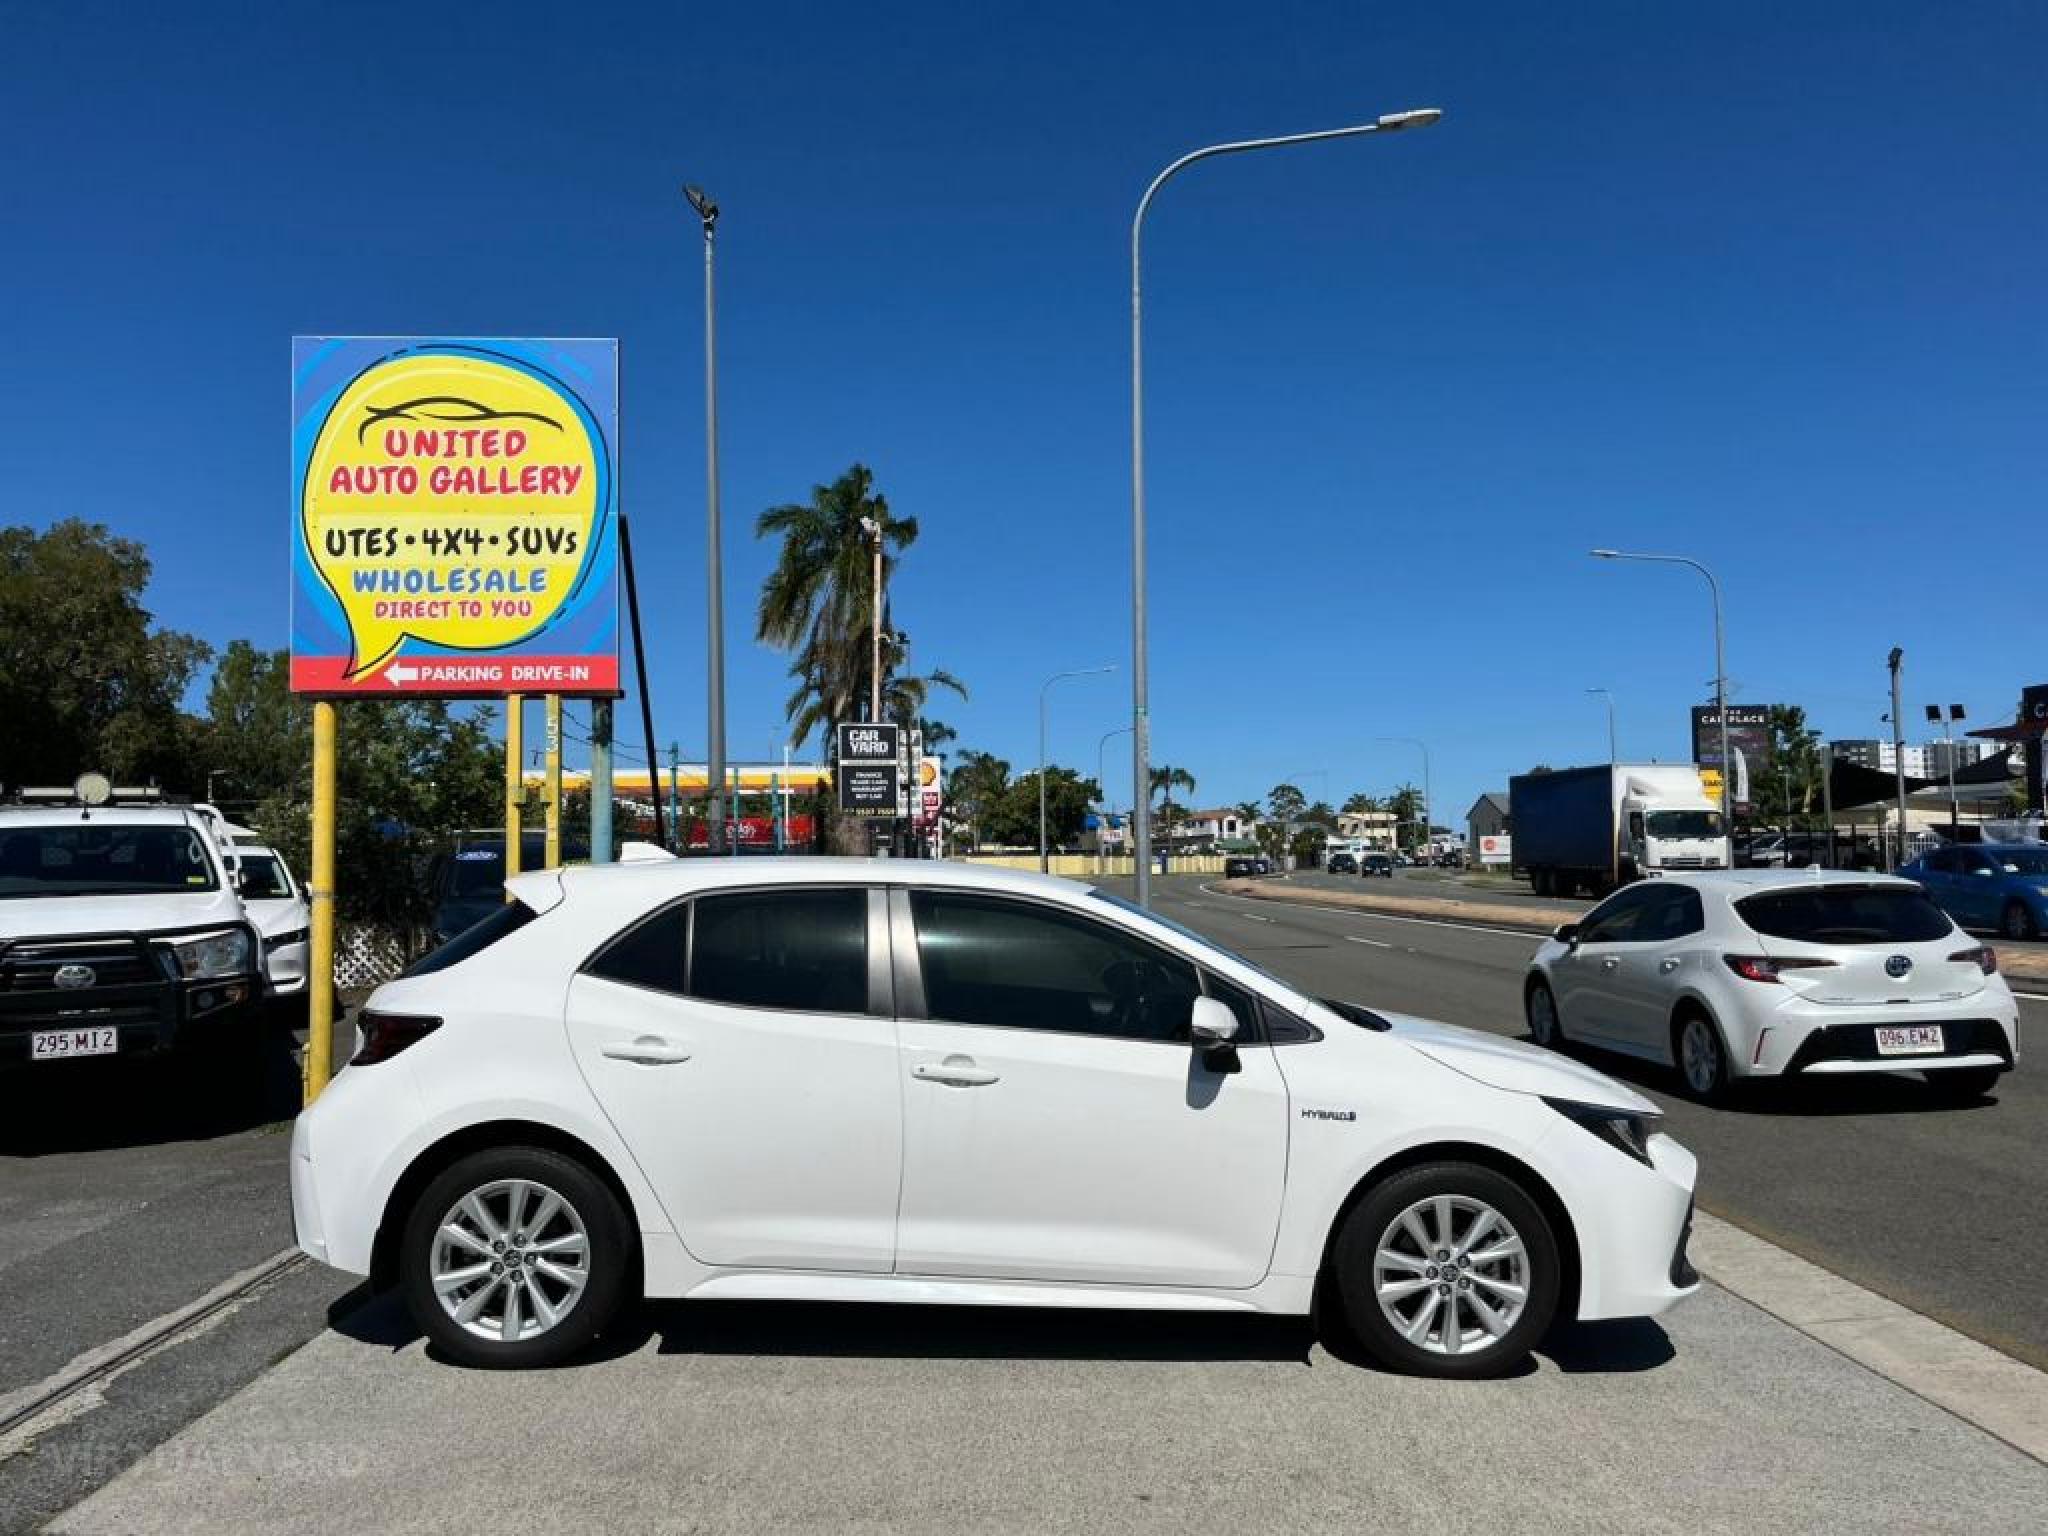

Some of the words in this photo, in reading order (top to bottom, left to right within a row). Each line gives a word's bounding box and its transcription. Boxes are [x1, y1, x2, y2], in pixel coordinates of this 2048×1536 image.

[385, 430, 527, 457] UNITED
[329, 465, 418, 494] AUTO
[430, 465, 582, 495] GALLERY
[326, 527, 398, 556] UTES
[423, 527, 484, 556] 4X4
[507, 527, 577, 556] SUVs
[353, 568, 548, 593] WHOLESALE
[375, 600, 450, 619] DIRECT
[458, 600, 482, 618] TO
[491, 600, 532, 618] YOU
[421, 666, 502, 681] PARKING
[511, 666, 588, 682] DRIVE-IN
[849, 729, 879, 741] CAR
[849, 741, 889, 753] YARD
[36, 1033, 68, 1052] 295
